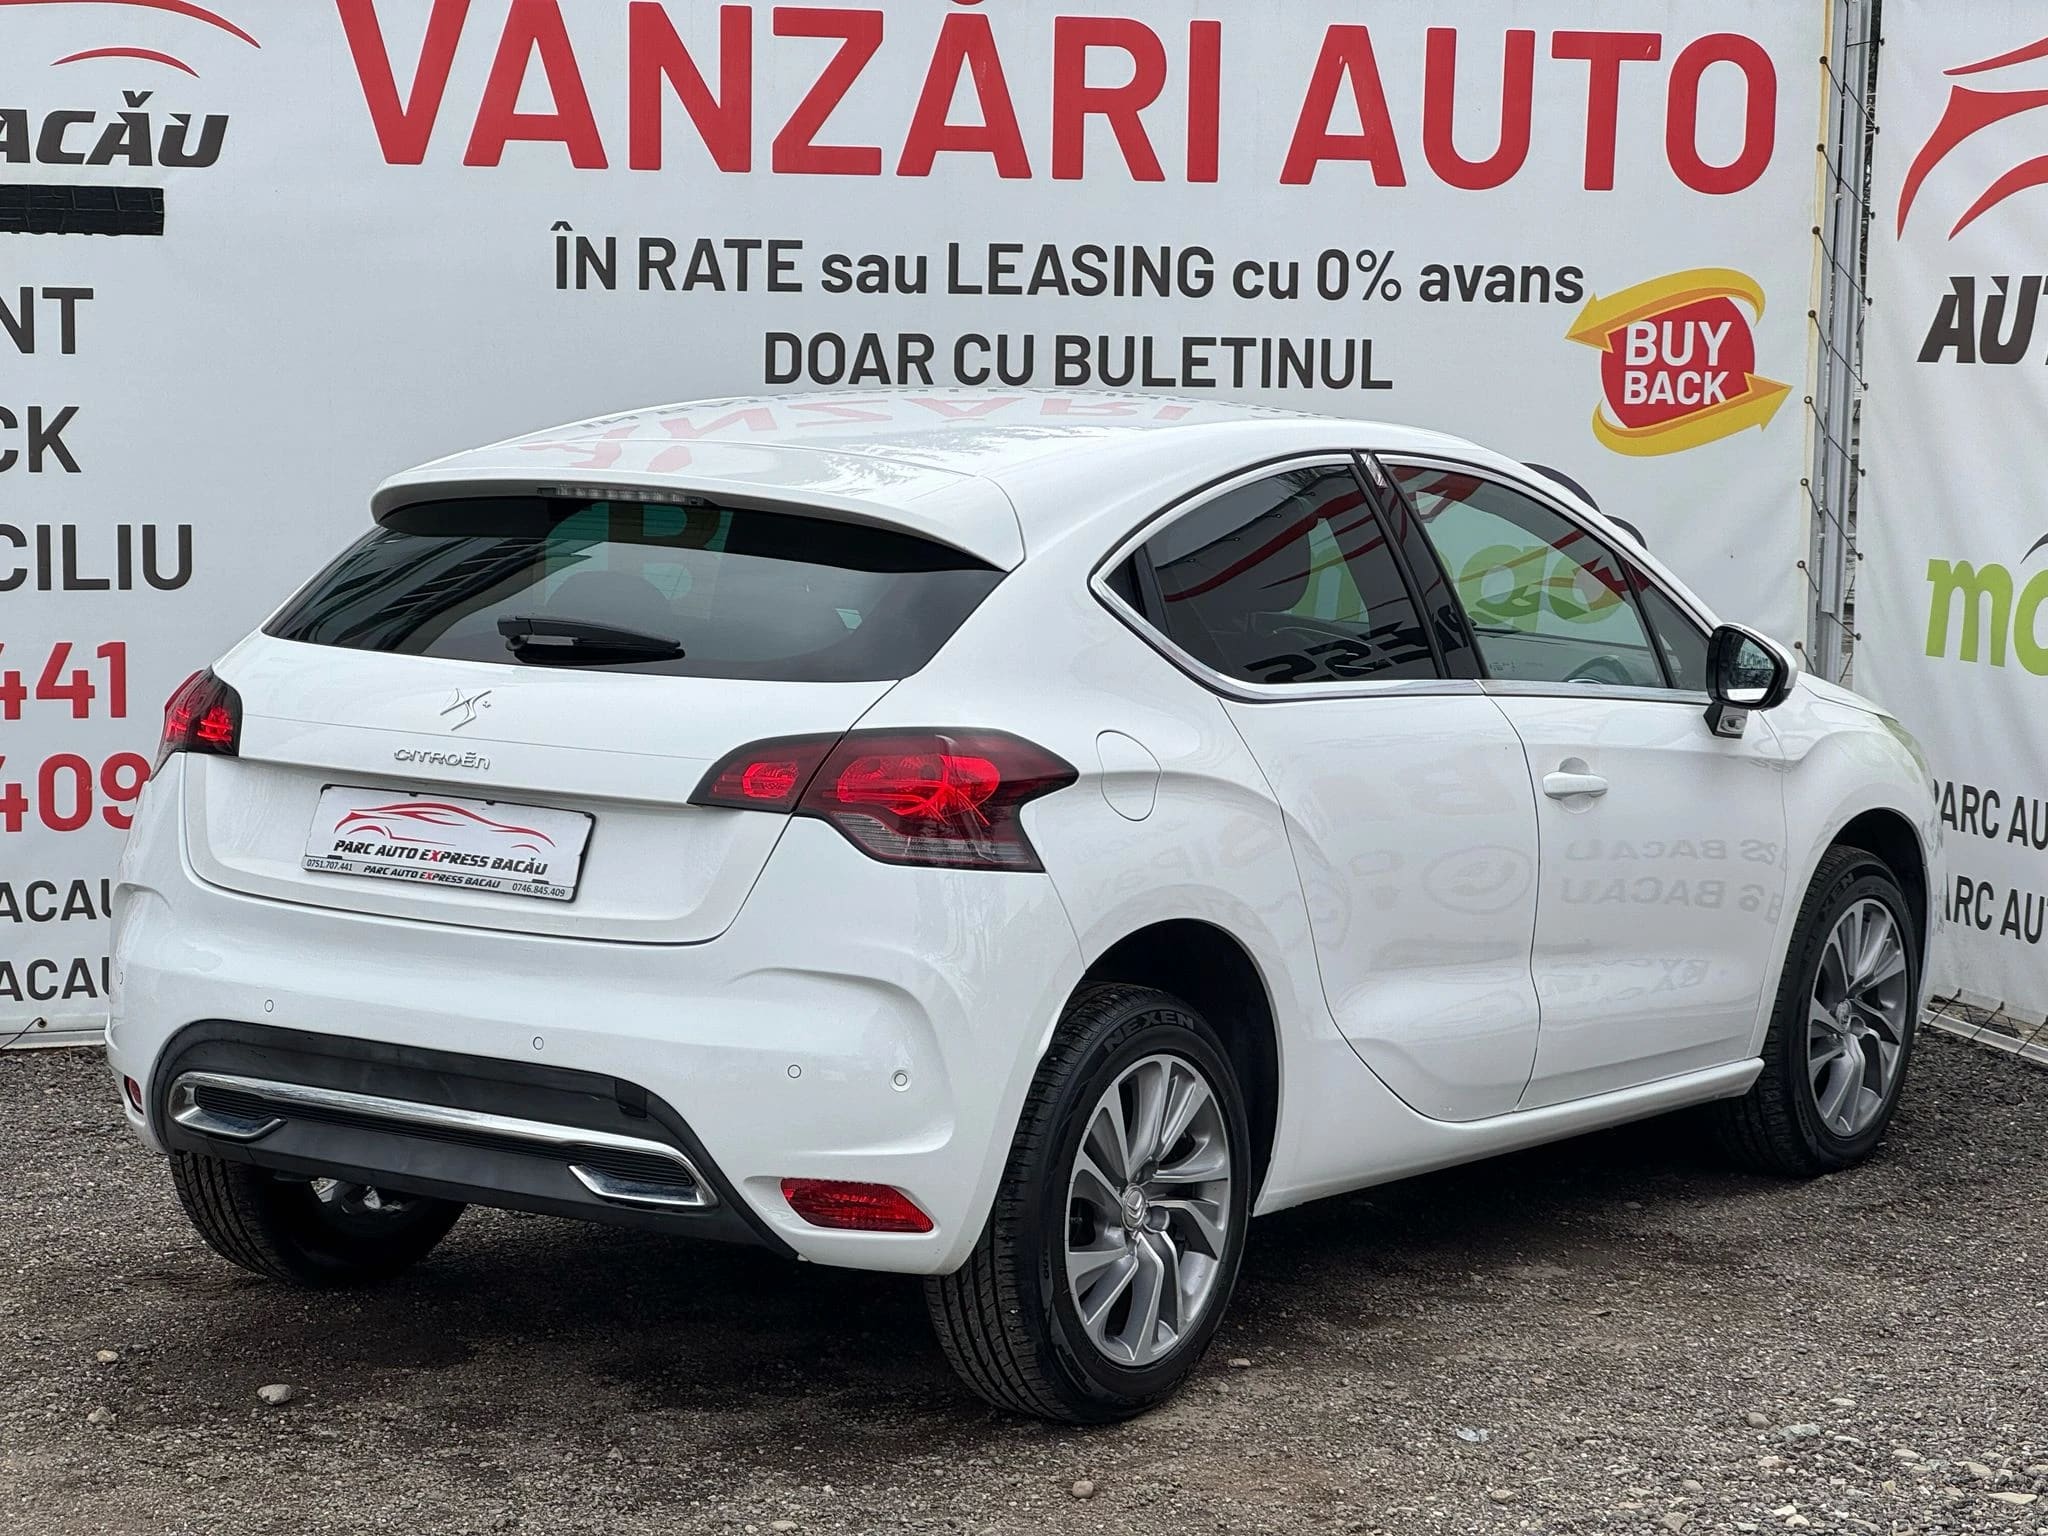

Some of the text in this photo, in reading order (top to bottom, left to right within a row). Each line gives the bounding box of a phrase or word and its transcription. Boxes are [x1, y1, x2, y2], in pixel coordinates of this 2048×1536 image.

[1280, 25, 1777, 194] AUTO
[551, 221, 1584, 304] ÎN RATE sau LEASING cu 0% avans
[1917, 275, 2048, 365] AU
[764, 332, 1393, 390] DOAR CU BULETINUL
[1625, 320, 1733, 367] BUY
[1624, 371, 1730, 405] BACK
[1934, 779, 2001, 838] ARC
[306, 859, 353, 871] 0751.707.441
[333, 840, 548, 875] PARC AUTO EXPRESS BACĂU
[363, 865, 501, 888] PARC AUTO EXPRESS BACAU
[512, 883, 565, 897] 0746.845.409
[1103, 1011, 1195, 1051] NEXEN
